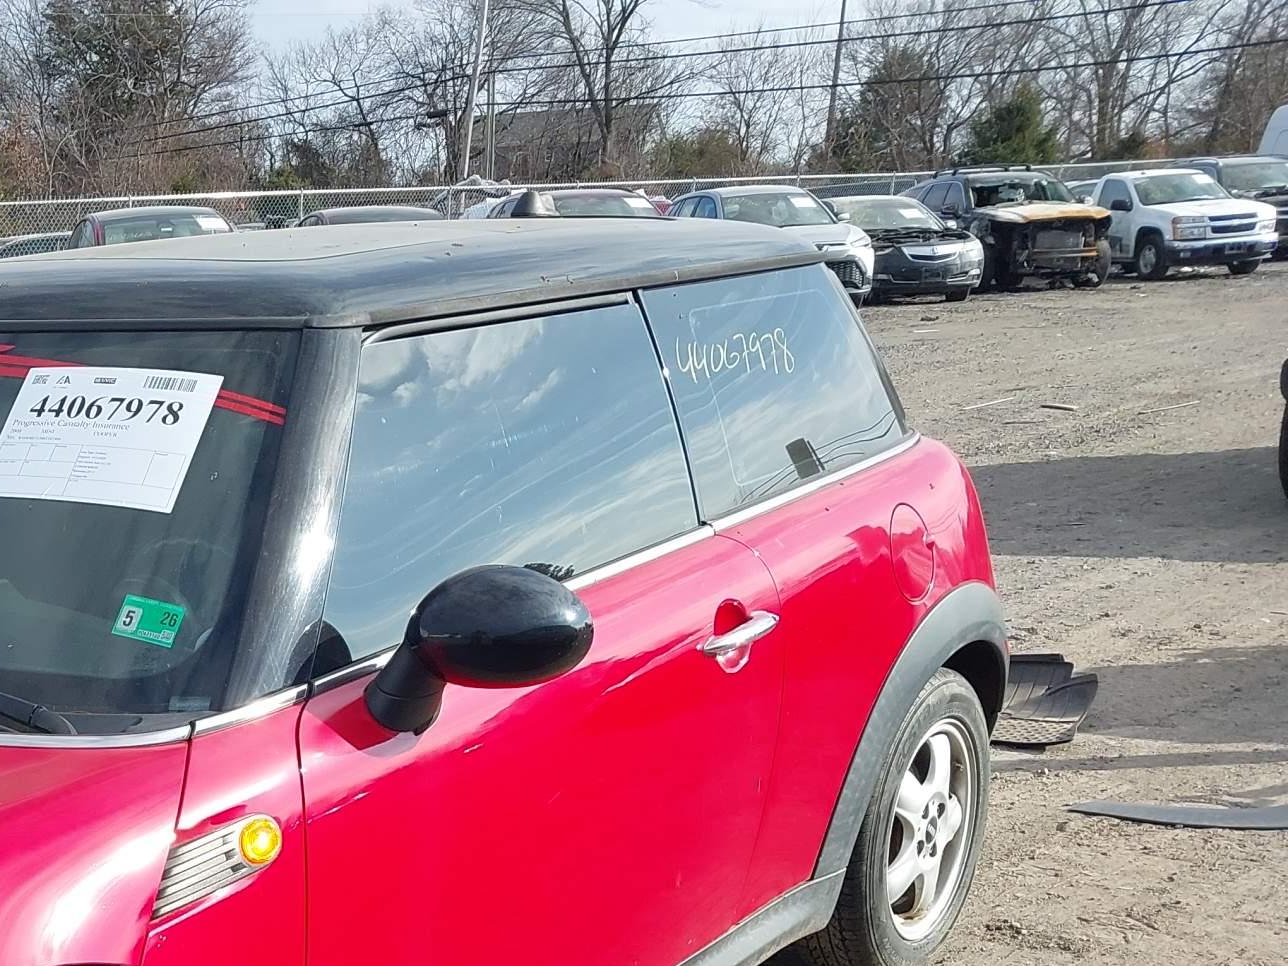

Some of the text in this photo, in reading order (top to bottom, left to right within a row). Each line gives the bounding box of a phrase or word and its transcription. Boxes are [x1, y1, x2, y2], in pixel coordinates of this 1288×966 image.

[676, 328, 795, 384] 44067978
[29, 394, 184, 426] 44067978
[12, 419, 130, 430] Progressive Casualty Insurance
[122, 610, 179, 627] 5 26
